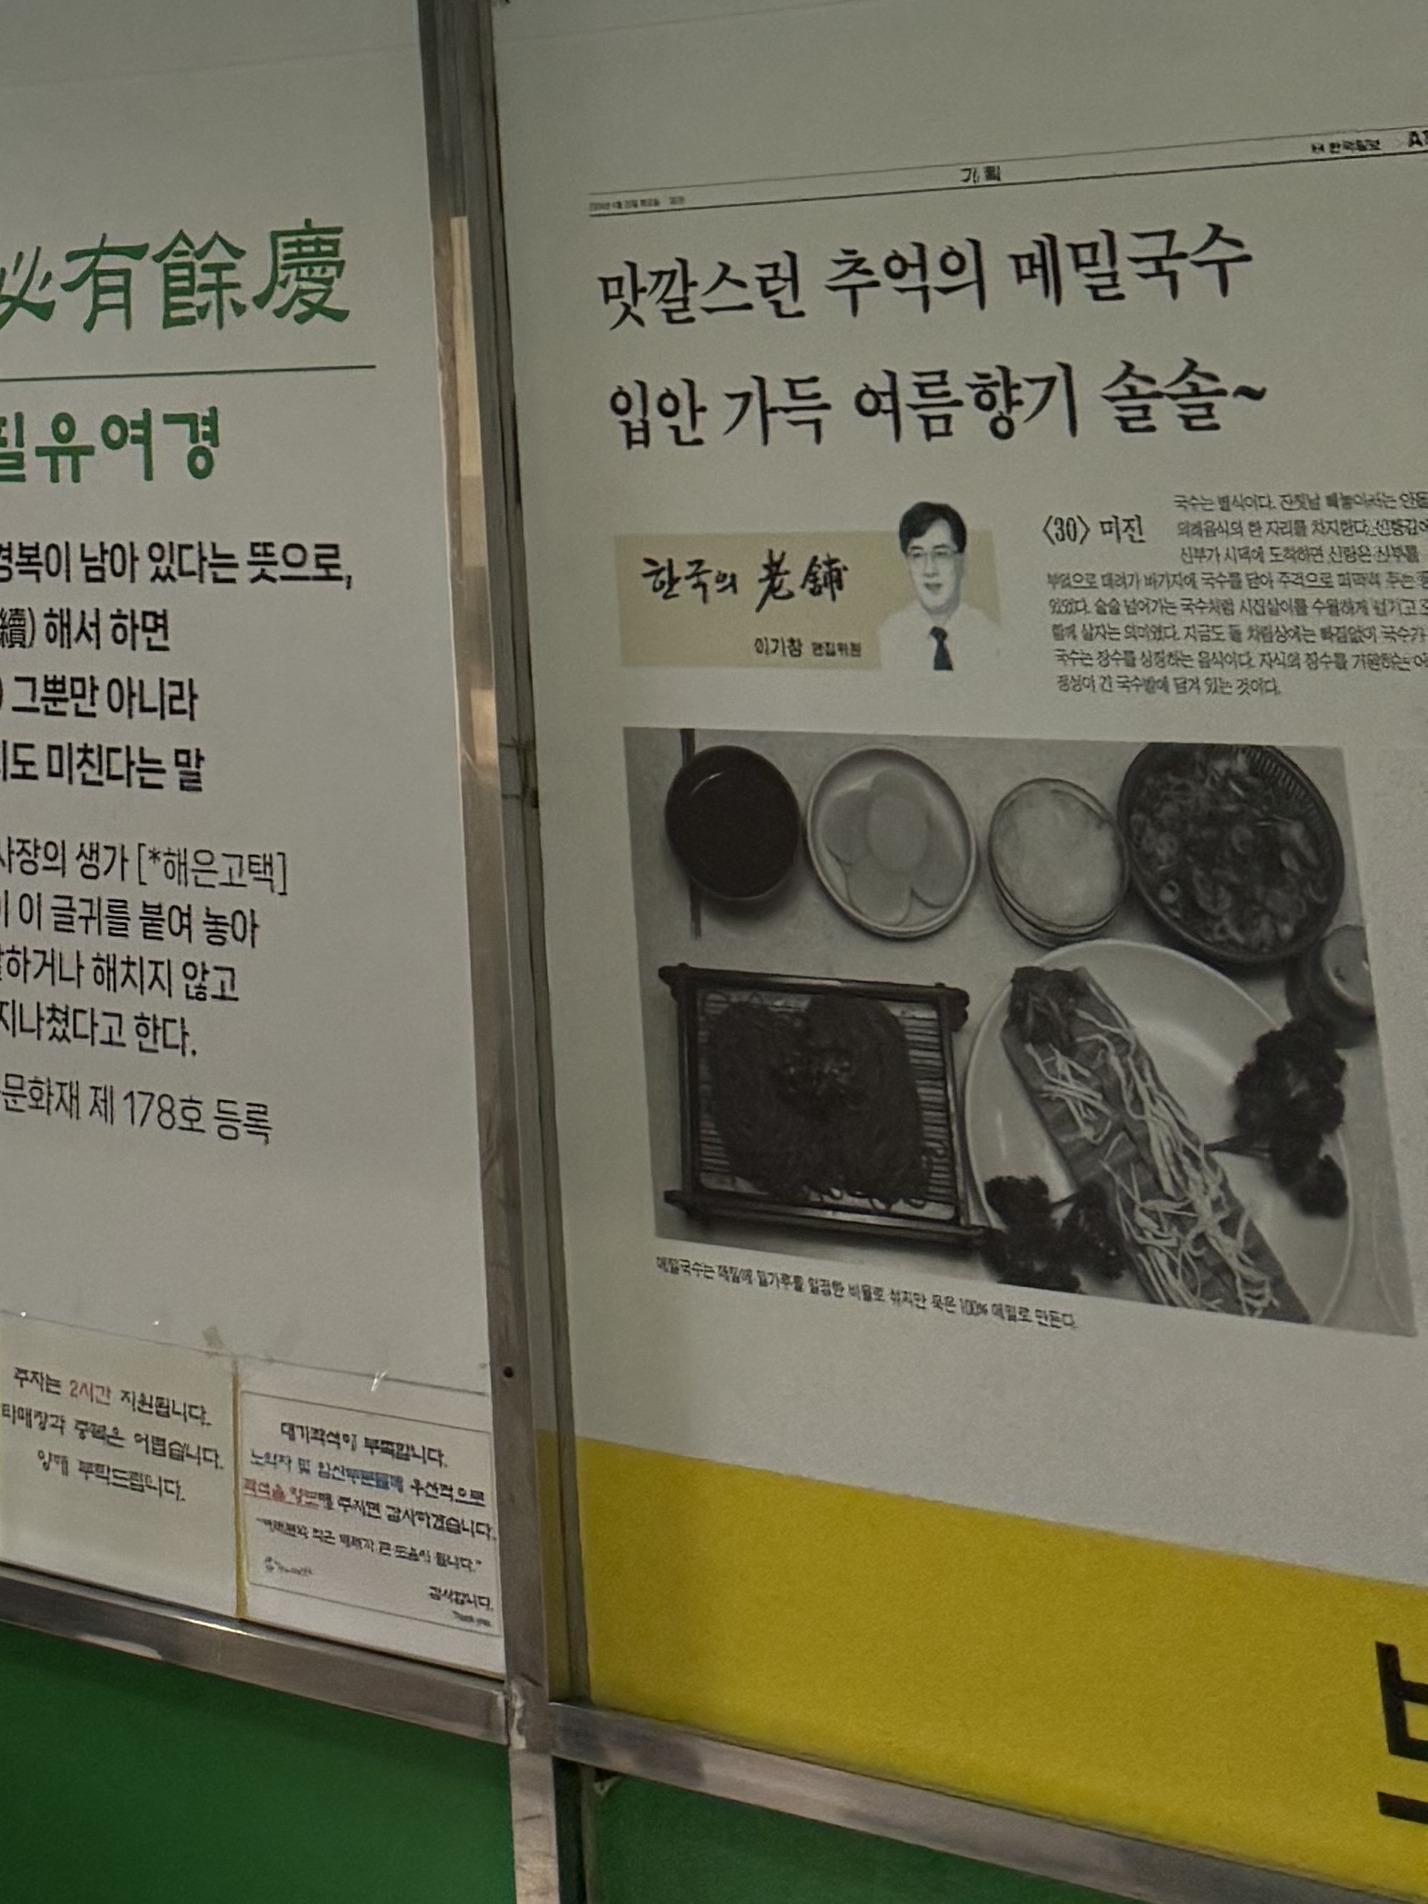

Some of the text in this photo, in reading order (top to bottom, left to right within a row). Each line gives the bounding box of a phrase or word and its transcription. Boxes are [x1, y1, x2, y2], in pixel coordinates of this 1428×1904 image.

[598, 221, 1254, 331] 맛깔스런 추억의 메밀국수
[608, 377, 707, 450] 입안
[723, 374, 832, 447] 가득
[853, 362, 1080, 443] 여름향기
[1174, 494, 1215, 512] 국수는
[1098, 514, 1146, 544] 미진
[80, 544, 139, 585] 남아
[147, 544, 239, 585] 있다는
[246, 543, 353, 590] 뜻으로,
[1180, 545, 1221, 564] 신부가
[641, 556, 738, 605] 한국의
[44, 607, 101, 651] 해서
[110, 607, 171, 653] 하면
[11, 673, 99, 718] 그뿐만
[107, 676, 199, 722] 아니라
[46, 743, 166, 791] 미친다는
[174, 746, 205, 793] 말
[75, 839, 128, 885] 생가
[18, 889, 44, 931] 이
[51, 891, 133, 940] 글귀를
[140, 898, 195, 945] 붙여
[202, 904, 259, 951] 놓아
[92, 951, 175, 1000] 해치지
[182, 958, 240, 1004] 않고
[134, 1010, 198, 1058] 한다.
[87, 1083, 116, 1127] 제
[123, 1087, 207, 1138] 178호
[213, 1097, 273, 1147] 등록
[69, 1379, 112, 1406] 2시간
